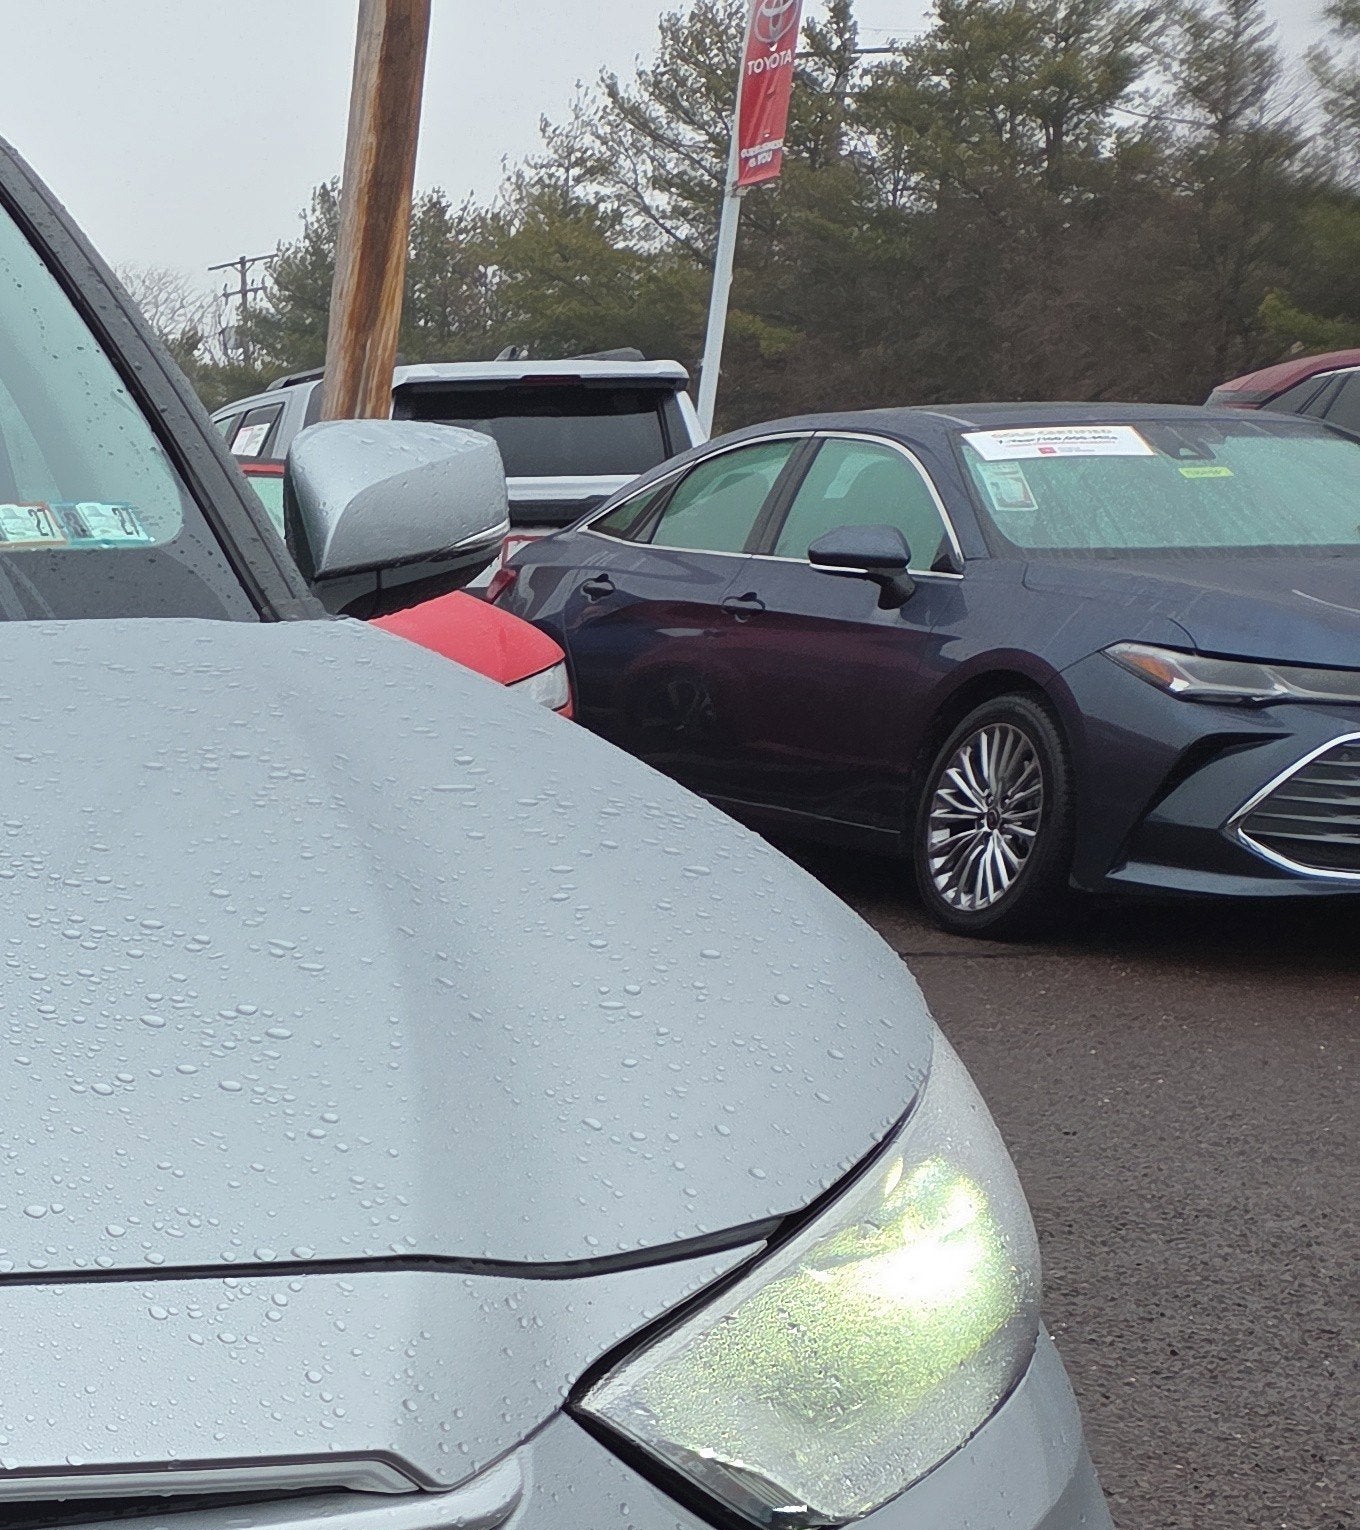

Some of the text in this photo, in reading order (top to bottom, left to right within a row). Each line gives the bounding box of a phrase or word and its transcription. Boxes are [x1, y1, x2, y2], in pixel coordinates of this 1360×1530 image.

[747, 49, 792, 75] TOYOTA
[28, 508, 56, 538] 27
[111, 507, 141, 537] 27
